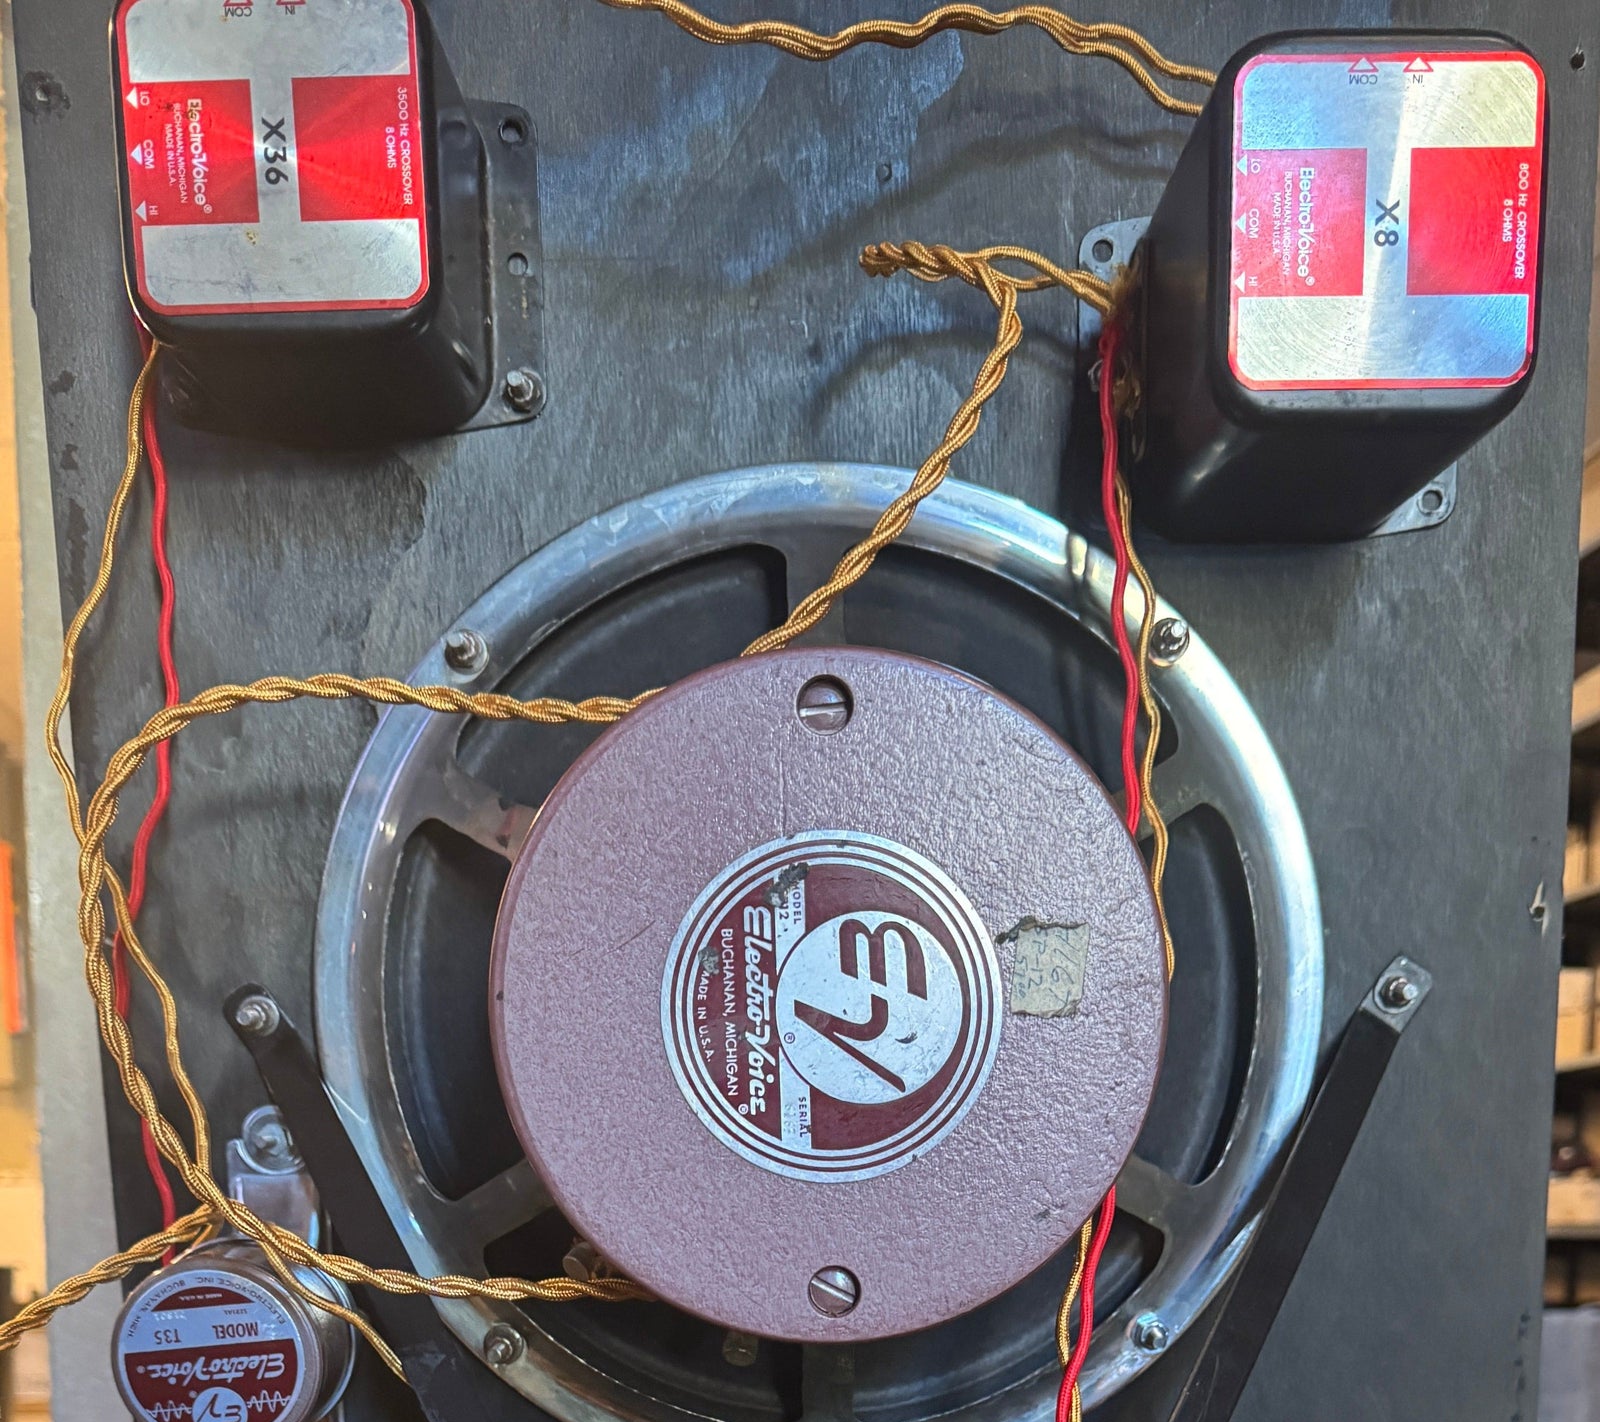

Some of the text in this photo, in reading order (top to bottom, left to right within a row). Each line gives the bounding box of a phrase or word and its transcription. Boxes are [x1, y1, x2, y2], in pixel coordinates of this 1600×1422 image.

[224, 6, 252, 17] COM
[285, 6, 295, 15] IN
[1349, 74, 1377, 85] COM
[1412, 74, 1423, 84] IN
[140, 91, 150, 106] LO
[143, 139, 155, 169] COM
[165, 123, 177, 186] MADE IN U.S.A.
[261, 117, 288, 185] X36
[385, 135, 396, 168] OHMS
[397, 87, 413, 205] 3500 Hz CROSSOVER
[177, 156, 188, 204] MICHIGAN
[1251, 159, 1261, 173] LO
[149, 205, 158, 215] HI
[1273, 192, 1281, 218] MADE
[1248, 208, 1260, 239] COM
[1273, 220, 1281, 230] IN
[1282, 171, 1293, 275] BUCHANAN, MICHIGAN
[1374, 199, 1400, 247] X8
[1502, 209, 1513, 243] OHMS
[1514, 162, 1529, 280] 800 Hz CROSSOVER
[1248, 276, 1258, 287] HI
[697, 1006, 707, 1020] IN
[720, 928, 738, 1096] BUCHANAN, MICHIGAN
[698, 1025, 714, 1062] U.S.A.
[798, 1096, 808, 1138] SERIAL
[194, 1276, 214, 1285] INC.
[153, 1321, 259, 1345] MODEL T35
